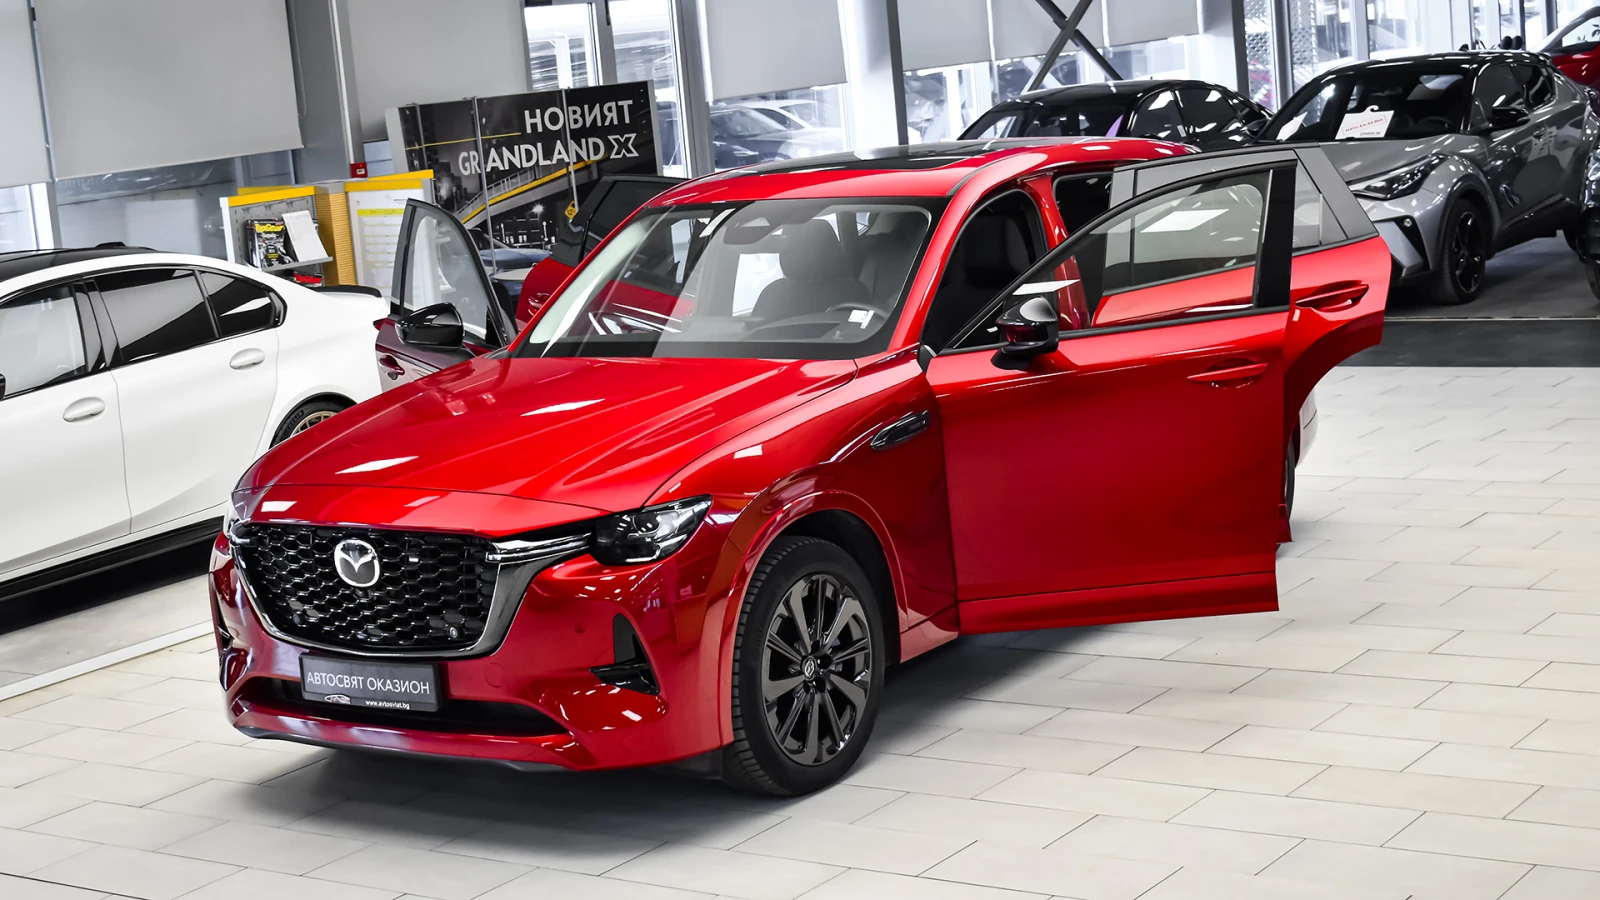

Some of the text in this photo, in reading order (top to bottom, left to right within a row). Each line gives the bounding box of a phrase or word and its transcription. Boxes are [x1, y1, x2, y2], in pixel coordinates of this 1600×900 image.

[524, 100, 634, 134] НОВИЯТ
[458, 133, 640, 176] GRANDLAND X
[307, 672, 430, 695] АВТОСВЯТ ОКАЗИОН
[365, 699, 410, 709] www.avtosviat.bg
